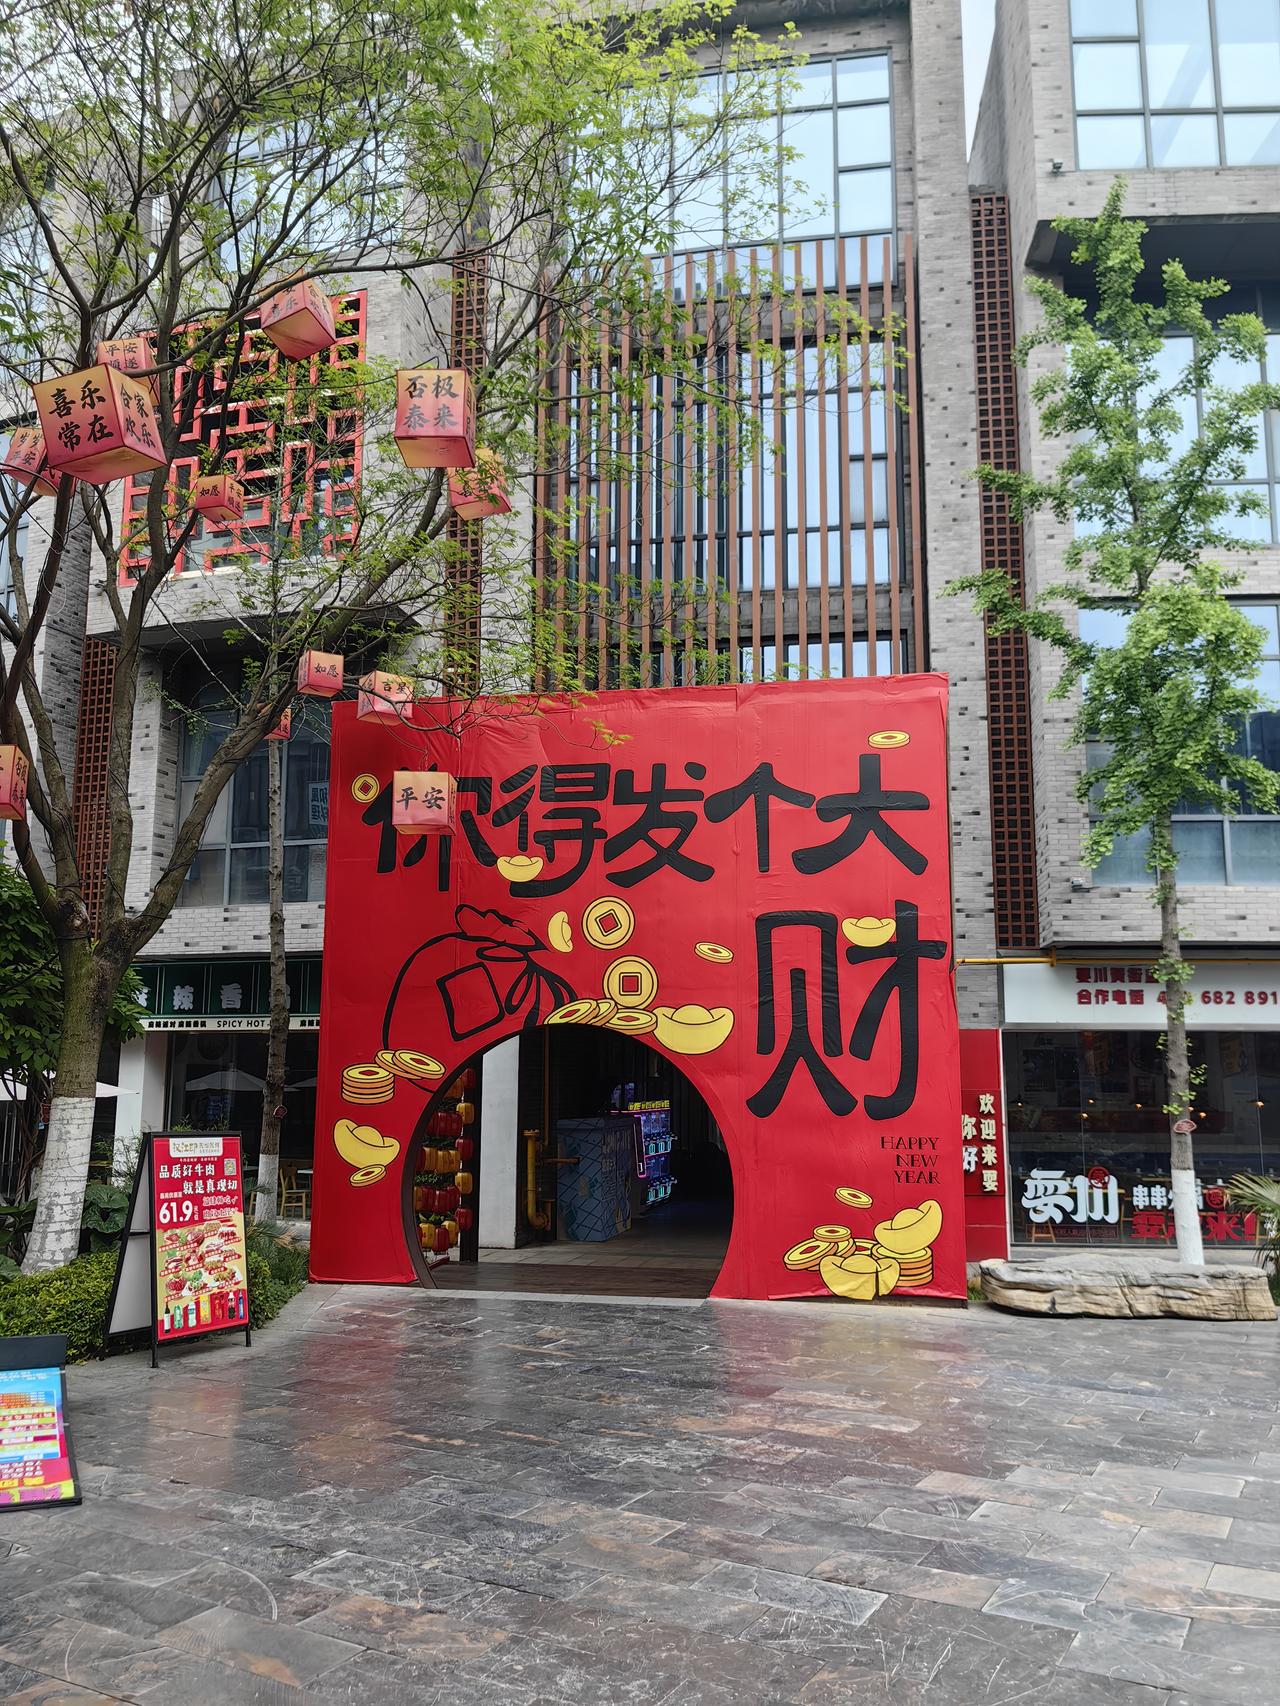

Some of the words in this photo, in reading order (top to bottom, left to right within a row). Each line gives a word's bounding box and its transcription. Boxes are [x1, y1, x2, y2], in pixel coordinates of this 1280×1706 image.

[106, 342, 138, 357] 平安
[404, 375, 459, 399] 否极
[49, 380, 106, 419] 喜乐
[120, 383, 149, 418] 合家
[402, 403, 459, 430] 泰来
[58, 414, 114, 452] 常在
[126, 415, 156, 448] 欢乐
[314, 663, 339, 678] 如愿
[396, 787, 445, 810] 平安
[1076, 989, 1144, 1005] 合作电话
[1201, 990, 1235, 1005] 682
[746, 900, 947, 1120] 财
[217, 1020, 242, 1028] SPICY
[246, 1020, 265, 1028] HOT
[881, 1136, 939, 1150] HAPPY
[159, 1163, 215, 1179] 品质好牛肉
[896, 1153, 940, 1168] NEW
[894, 1169, 941, 1184] YEAR
[159, 1200, 193, 1224] 61.9
